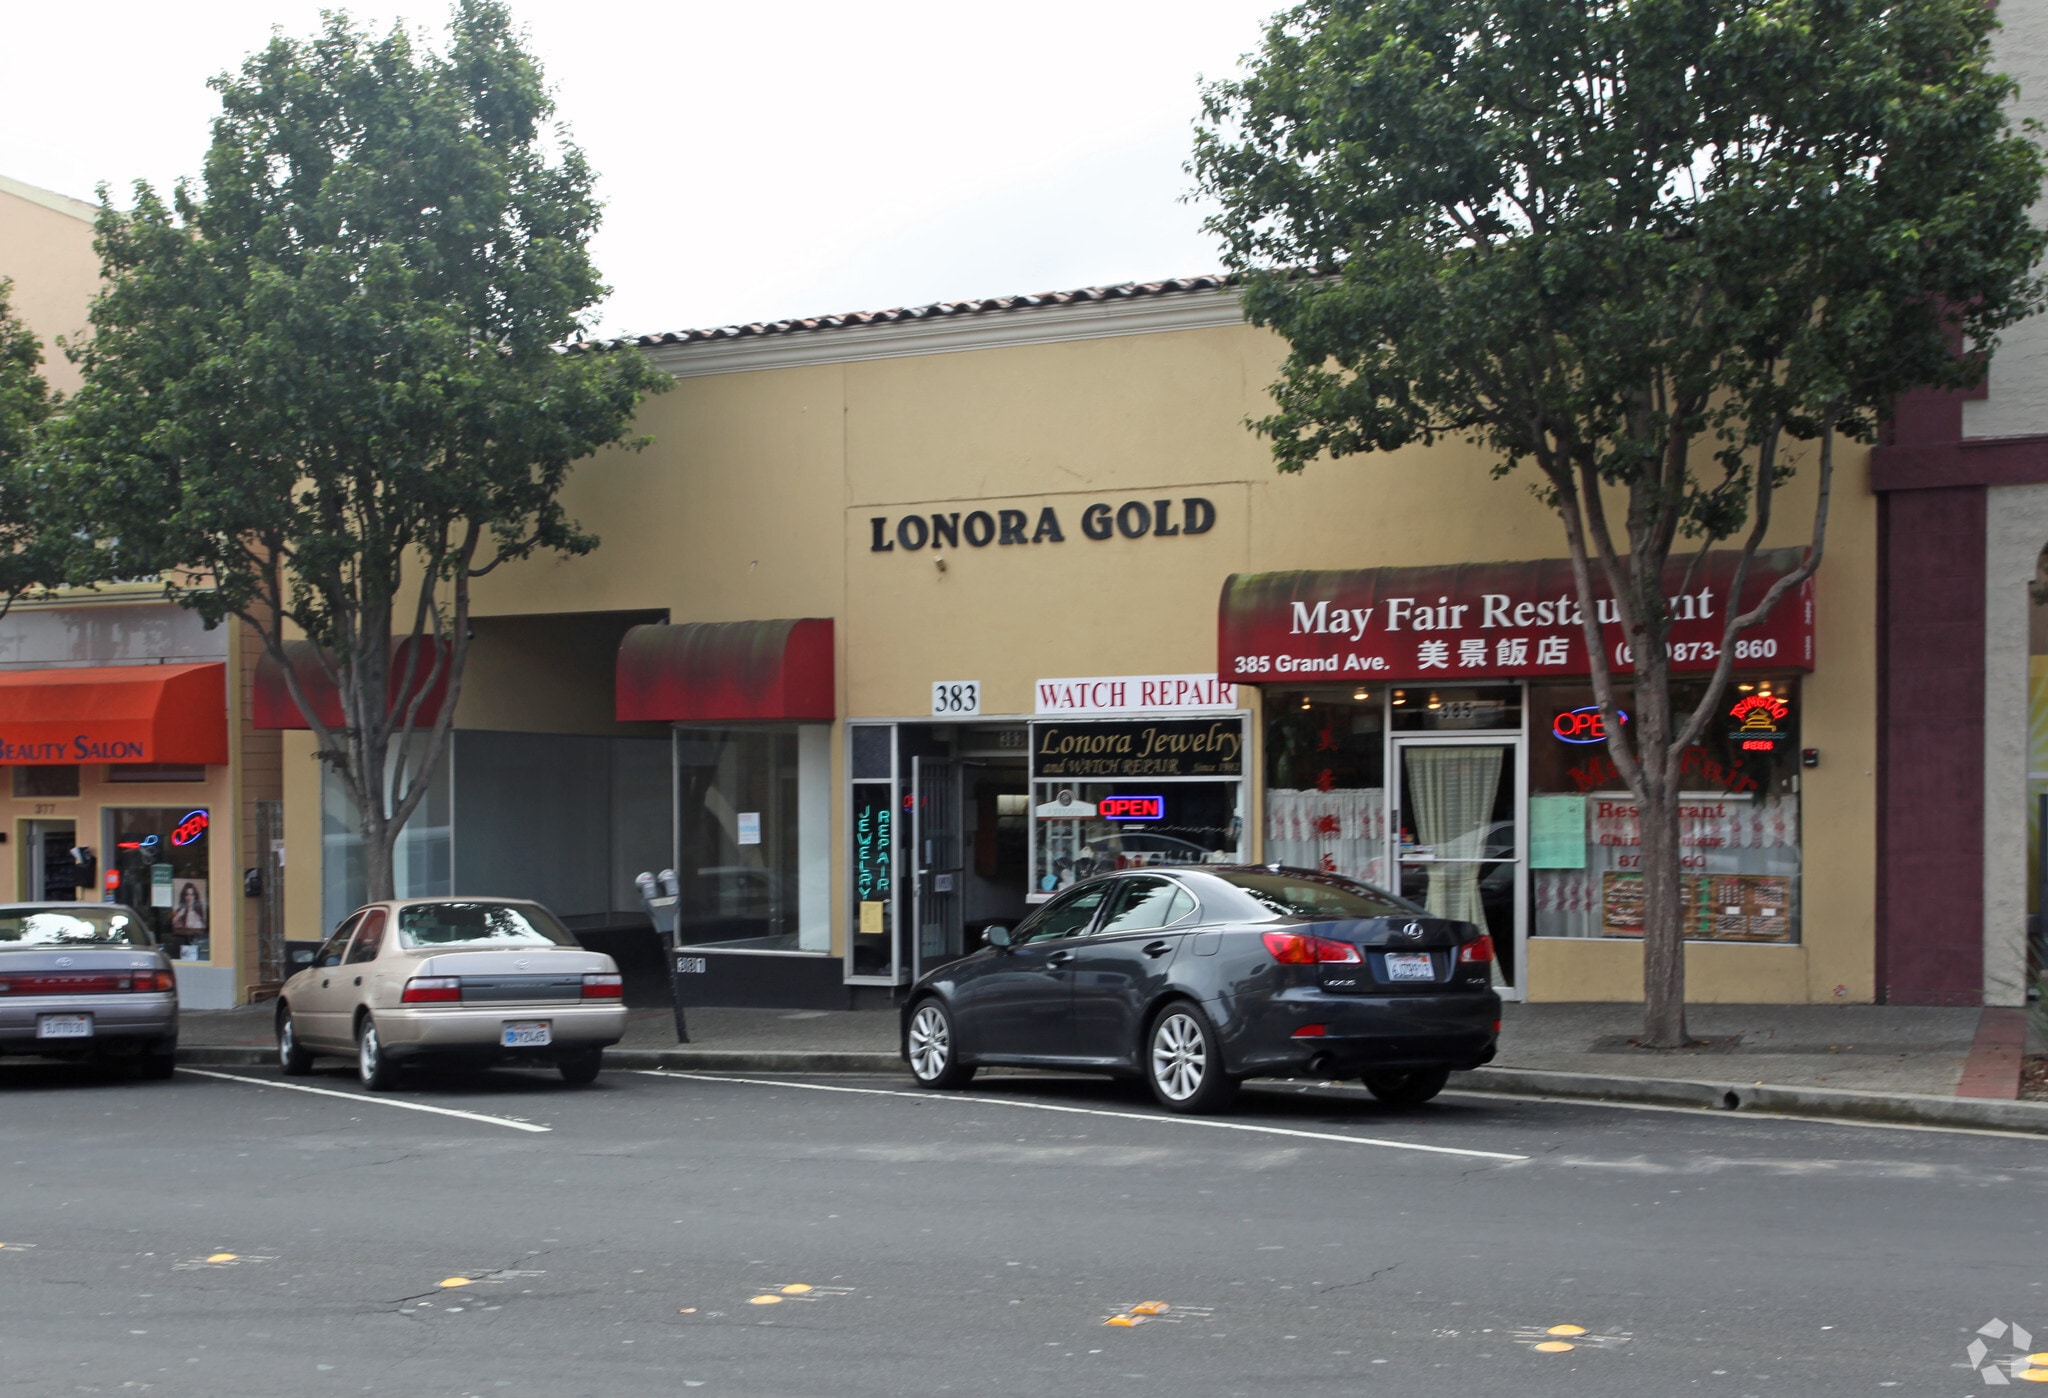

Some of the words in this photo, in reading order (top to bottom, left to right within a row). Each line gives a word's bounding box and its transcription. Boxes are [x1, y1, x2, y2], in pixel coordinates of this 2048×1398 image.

[870, 507, 1065, 551] LONORA
[1081, 498, 1216, 540] GOLD
[1289, 600, 1373, 642] May
[1384, 596, 1469, 631] Fair
[1480, 586, 1715, 629] Restaunt
[1234, 655, 1271, 673] 385
[1275, 654, 1339, 672] Grand
[1343, 653, 1390, 671] Ave.
[1417, 635, 1569, 670] 美景飯店
[935, 684, 977, 712] 383
[1039, 682, 1127, 709] WATCH
[1141, 678, 1234, 706] REPAIR
[1729, 696, 1789, 722] TSINGTAO
[1553, 712, 1626, 737] OPE
[74, 735, 145, 760] SALON
[1039, 729, 1132, 755] Lonora
[1136, 723, 1243, 762] Jewelry
[1742, 740, 1774, 751] BEER
[1068, 759, 1121, 774] WATCH
[1122, 758, 1181, 775] REPAIR
[1680, 745, 1760, 793] Fair
[35, 803, 56, 815] 377
[1100, 800, 1159, 816] OPEN
[171, 815, 209, 846] OPEN
[856, 805, 872, 900] JEWELRY
[876, 810, 890, 891] REPAIR
